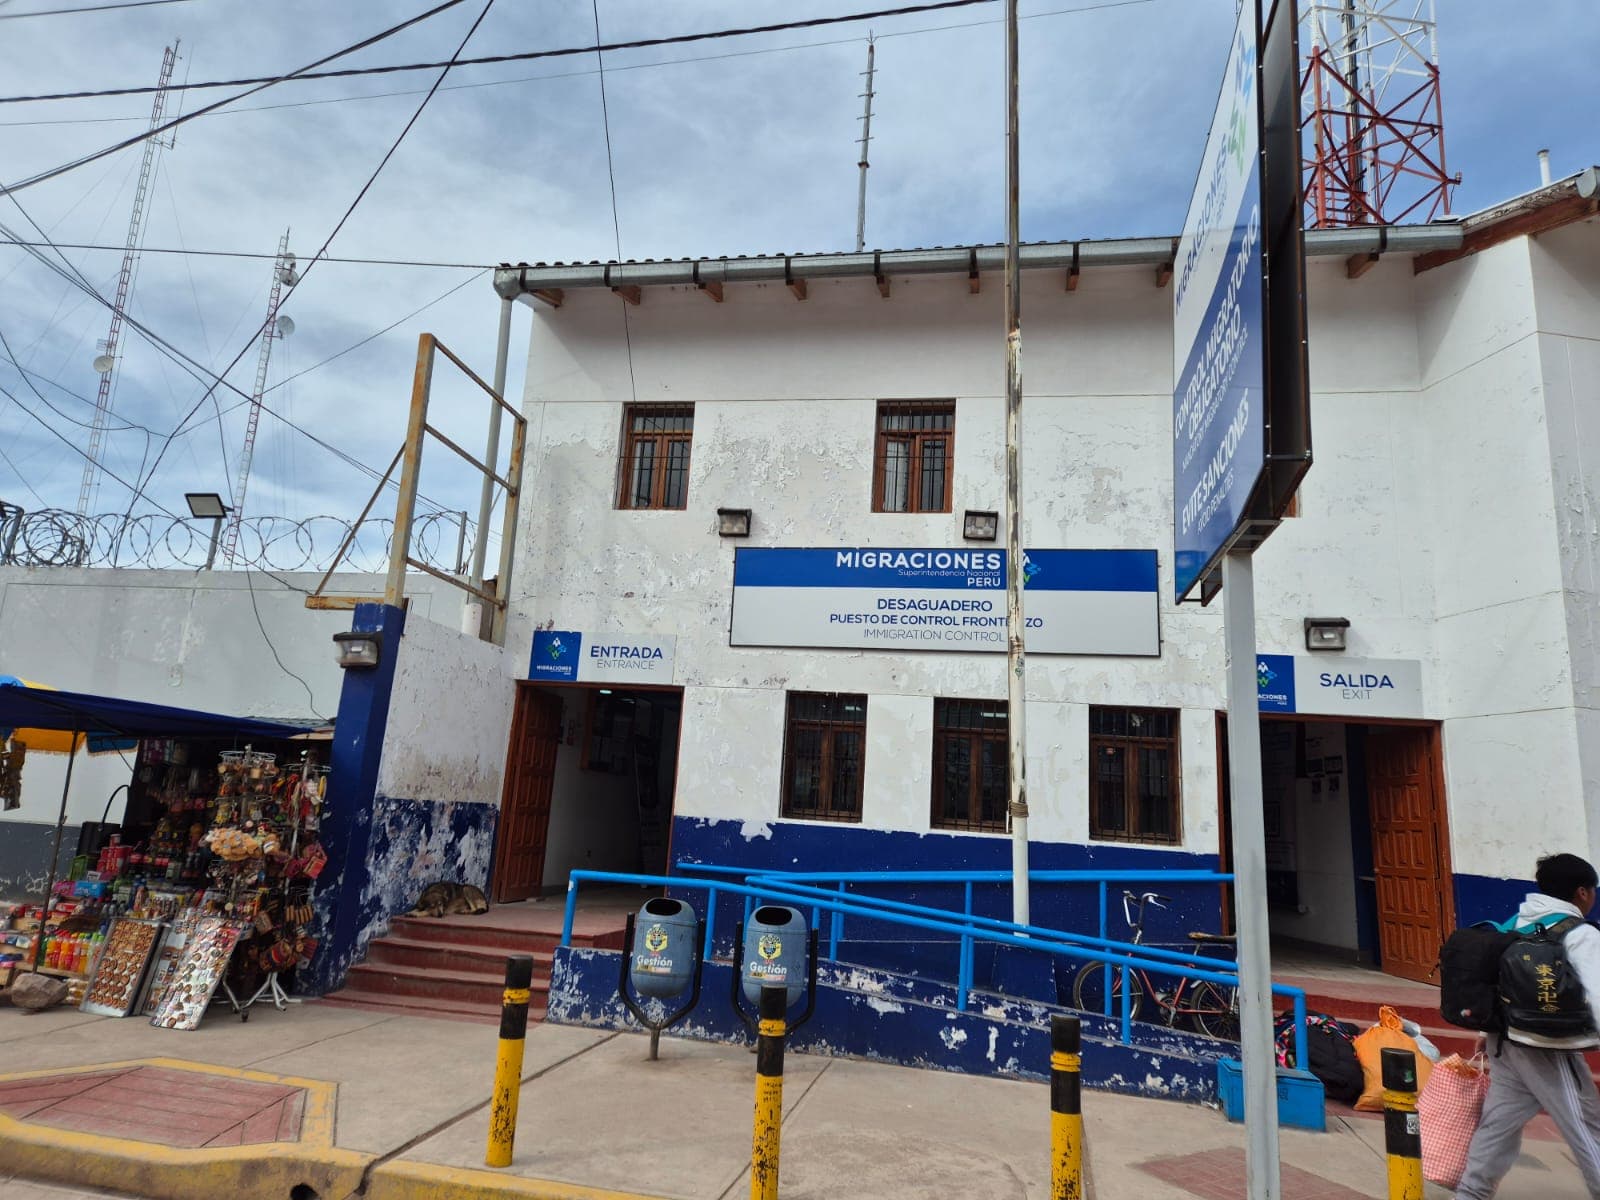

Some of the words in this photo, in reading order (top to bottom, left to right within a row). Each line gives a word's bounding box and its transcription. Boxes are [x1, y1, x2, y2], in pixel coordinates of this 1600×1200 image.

[1176, 132, 1227, 317] MIGRACIONES
[1175, 354, 1206, 439] CONTROL
[1206, 204, 1258, 366] MIGRATORIO
[1188, 303, 1241, 440] OBLIGATORIO
[1182, 482, 1203, 536] EVITE
[1202, 387, 1249, 500] SANCIONES
[836, 551, 1001, 569] MIGRACIONES
[898, 569, 965, 577] Superintendencia
[966, 569, 1001, 577] Nacional
[877, 598, 993, 612] DESAGUADERO
[829, 614, 879, 624] PUESTO
[881, 615, 898, 624] DE
[900, 615, 960, 626] CONTROL
[962, 616, 1044, 628] FRONTZO
[863, 628, 942, 640] IMMIGRATION
[944, 630, 1006, 642] CONTROL
[590, 646, 663, 659] ENTRADA
[596, 660, 656, 670] ENTRANCE
[1320, 673, 1394, 688] SALIDA
[1342, 689, 1373, 700] EXIT
[637, 954, 673, 968] Gestión
[750, 961, 787, 975] Gestión
